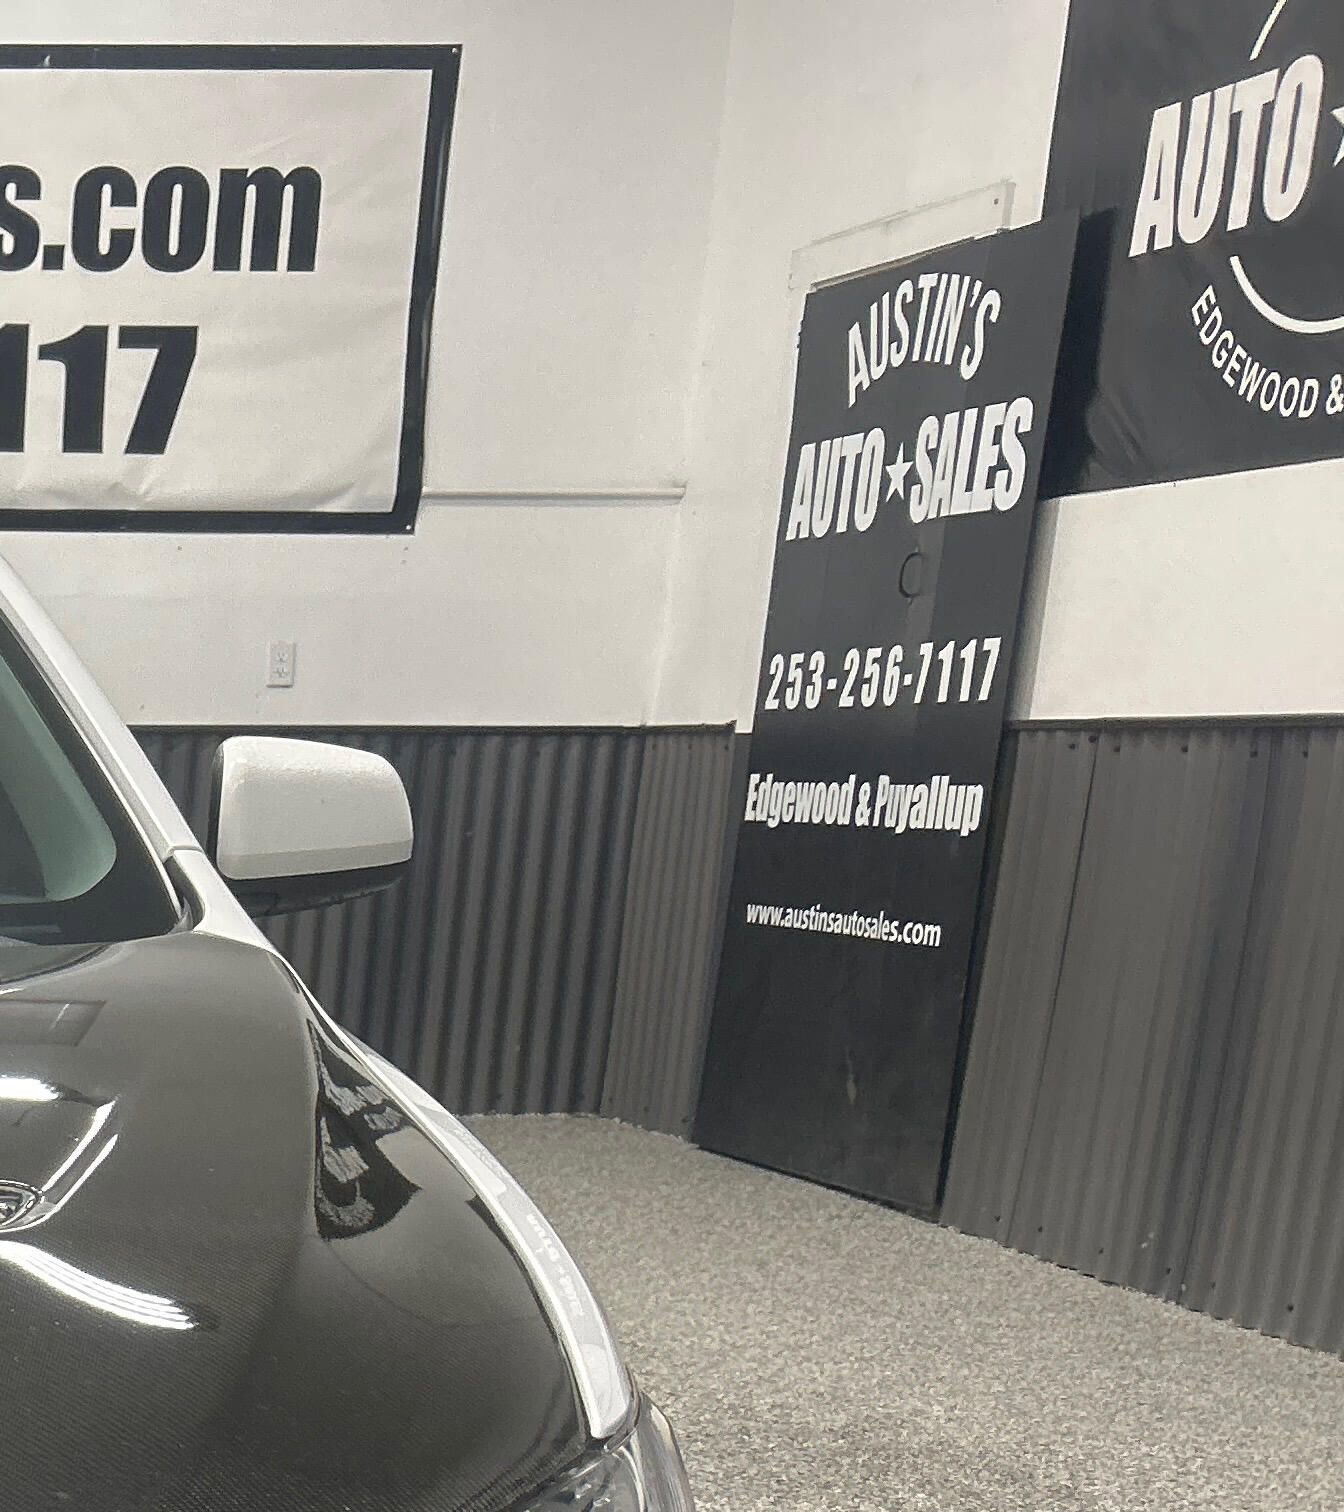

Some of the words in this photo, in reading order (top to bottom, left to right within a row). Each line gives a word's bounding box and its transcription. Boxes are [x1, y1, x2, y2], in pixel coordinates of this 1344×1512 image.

[1128, 54, 1324, 258] AUTO
[847, 272, 1001, 408] AUSTIN'S
[1192, 285, 1318, 419] EDGEWOOD
[785, 427, 885, 541] AUTO
[910, 396, 1033, 524] SALES
[766, 635, 1002, 711] 253-256-7117
[744, 773, 856, 828] Edgewood
[855, 780, 872, 827] &
[872, 775, 984, 837] Puyallup
[745, 903, 942, 947] www.austinsautosales.com
